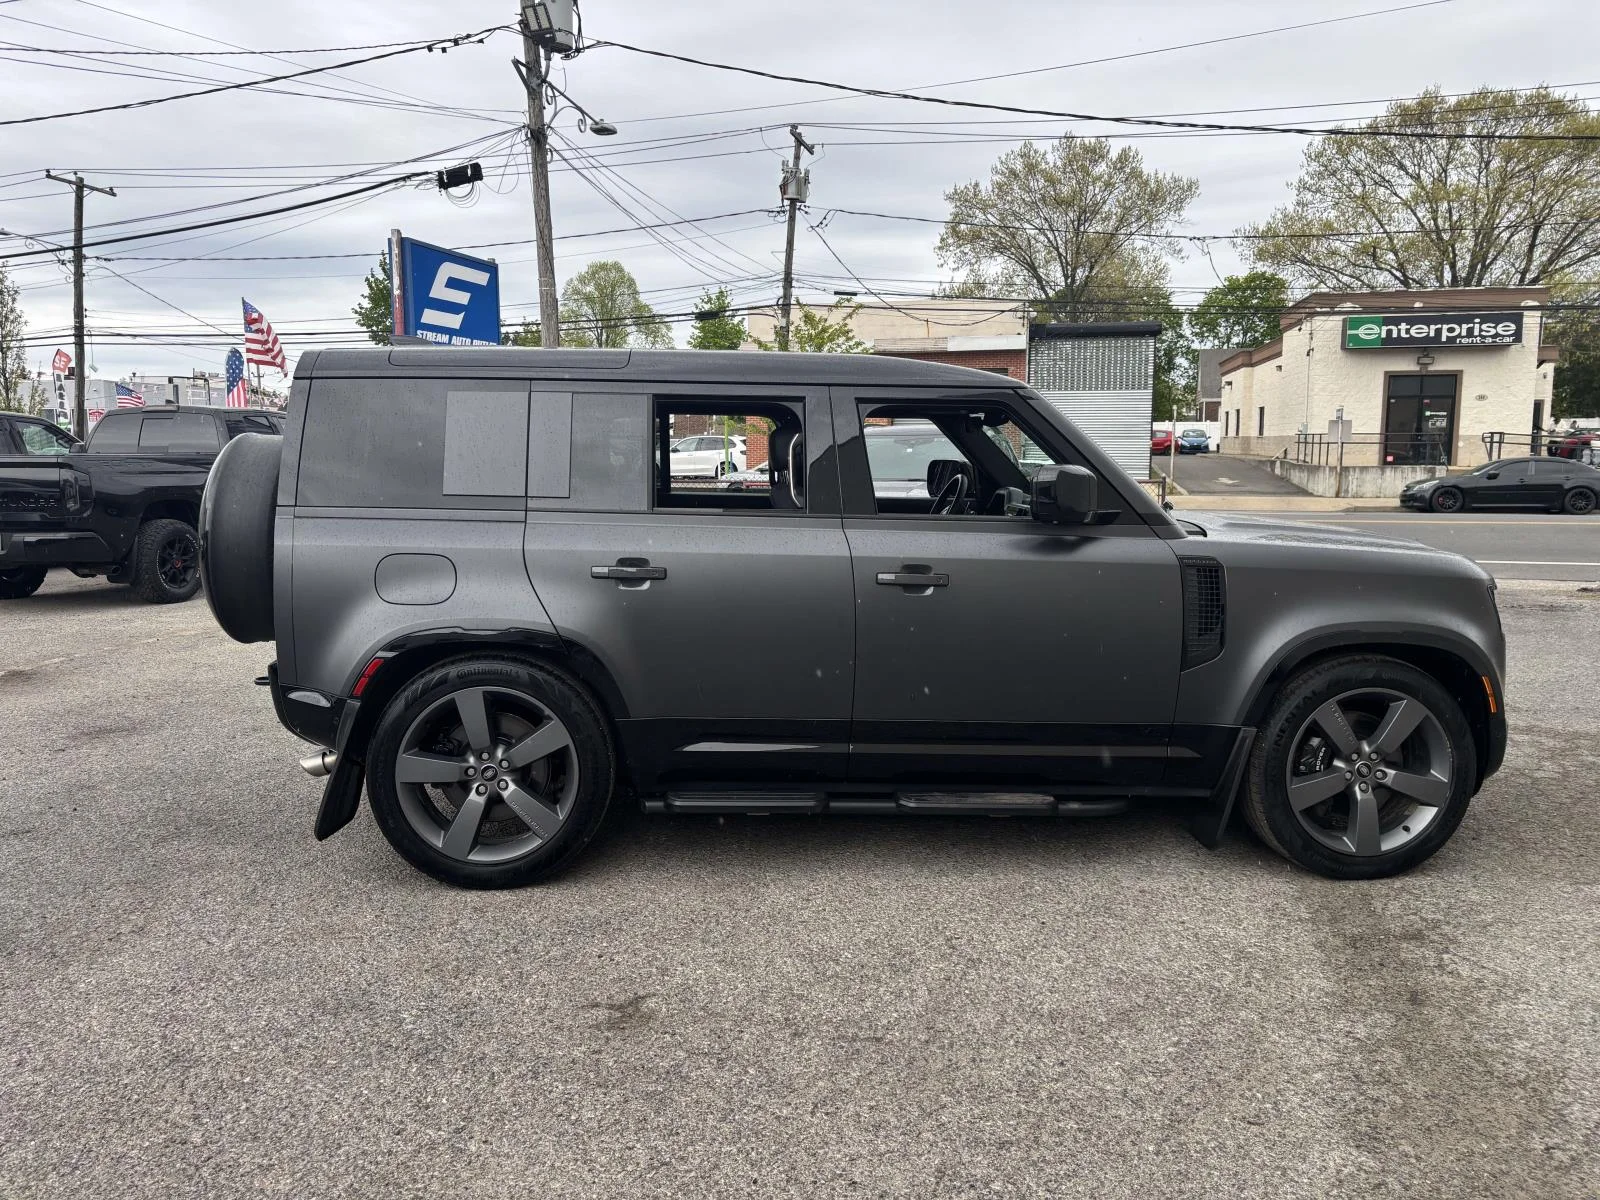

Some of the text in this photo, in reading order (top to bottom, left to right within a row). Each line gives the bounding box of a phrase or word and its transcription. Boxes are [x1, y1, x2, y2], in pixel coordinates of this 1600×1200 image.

[416, 329, 450, 344] STREAM
[1358, 318, 1517, 341] enterprise
[1456, 335, 1516, 344] rent-a-car
